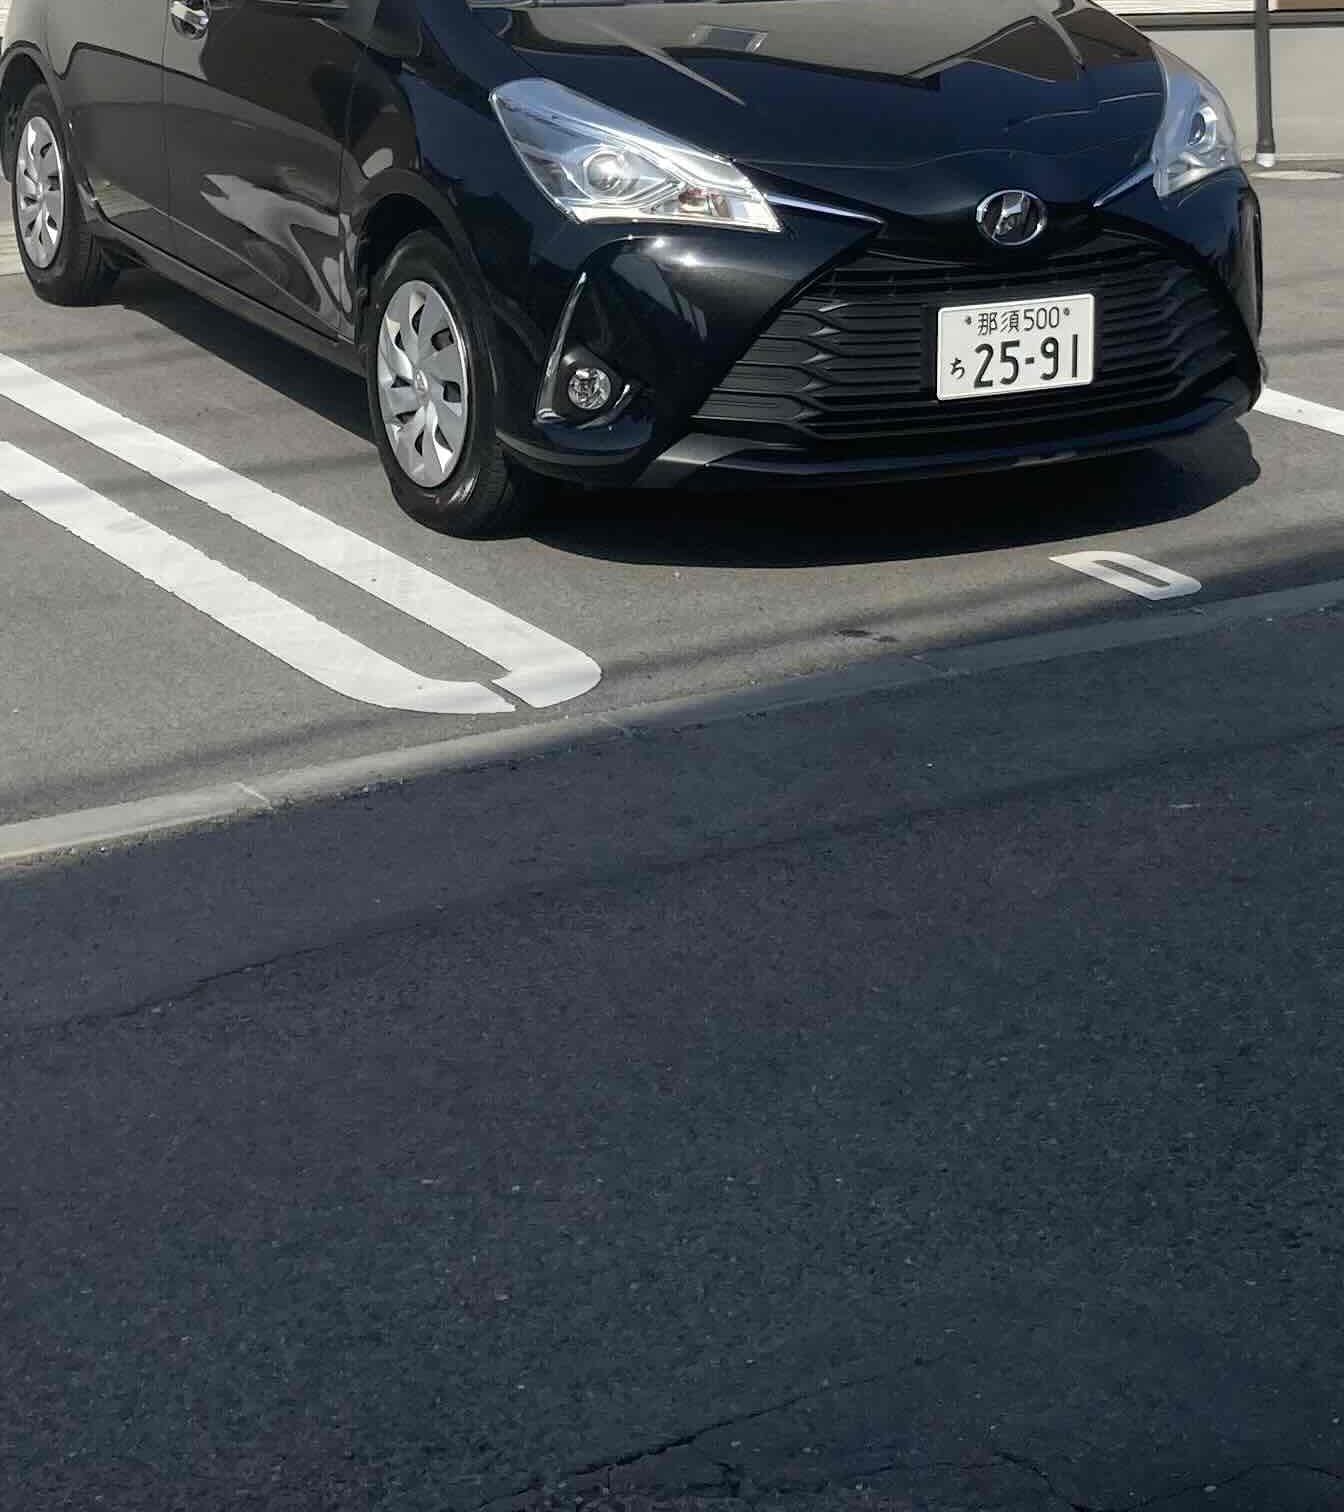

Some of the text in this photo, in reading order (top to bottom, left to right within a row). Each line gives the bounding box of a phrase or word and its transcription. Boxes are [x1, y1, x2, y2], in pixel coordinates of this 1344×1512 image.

[977, 306, 1060, 336] 那須500
[950, 334, 1078, 388] ち 25-91
